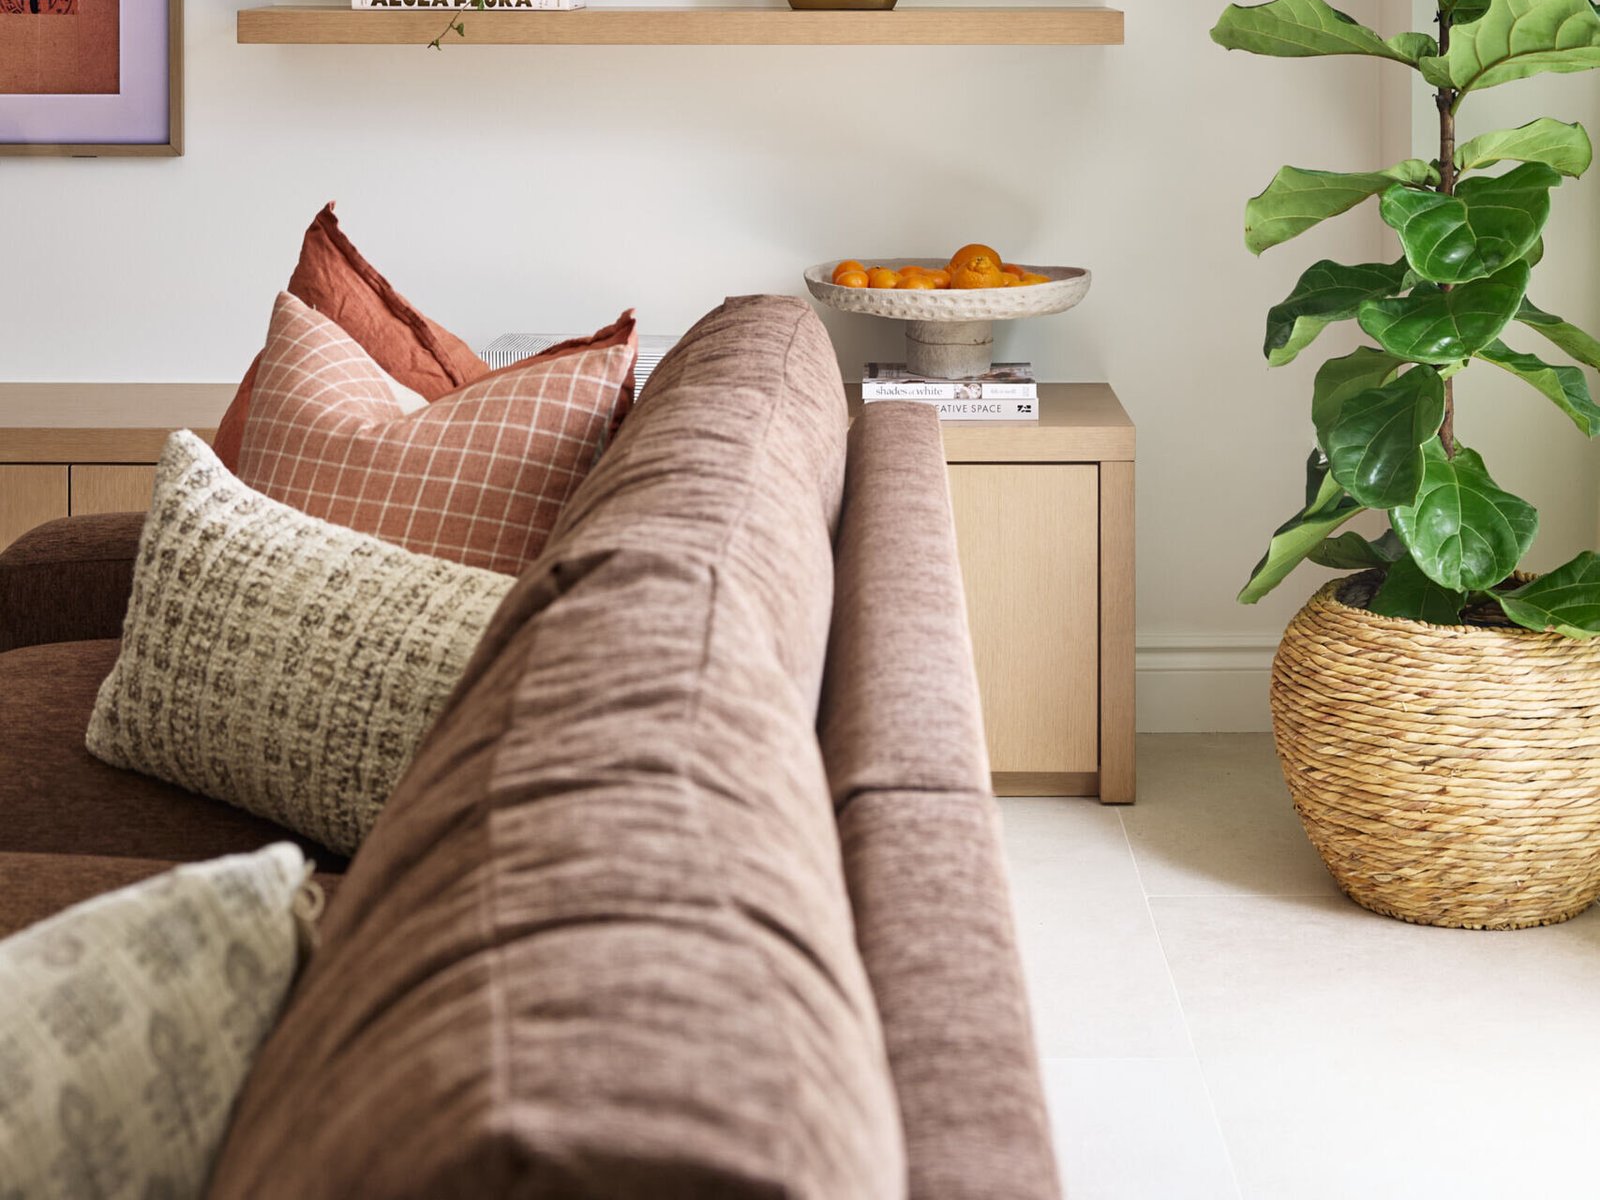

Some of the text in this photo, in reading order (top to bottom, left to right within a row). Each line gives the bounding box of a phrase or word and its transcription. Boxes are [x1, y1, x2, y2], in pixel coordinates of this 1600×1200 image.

[875, 386, 908, 396] shades
[916, 386, 943, 396] white
[971, 404, 1002, 413] SPACE
